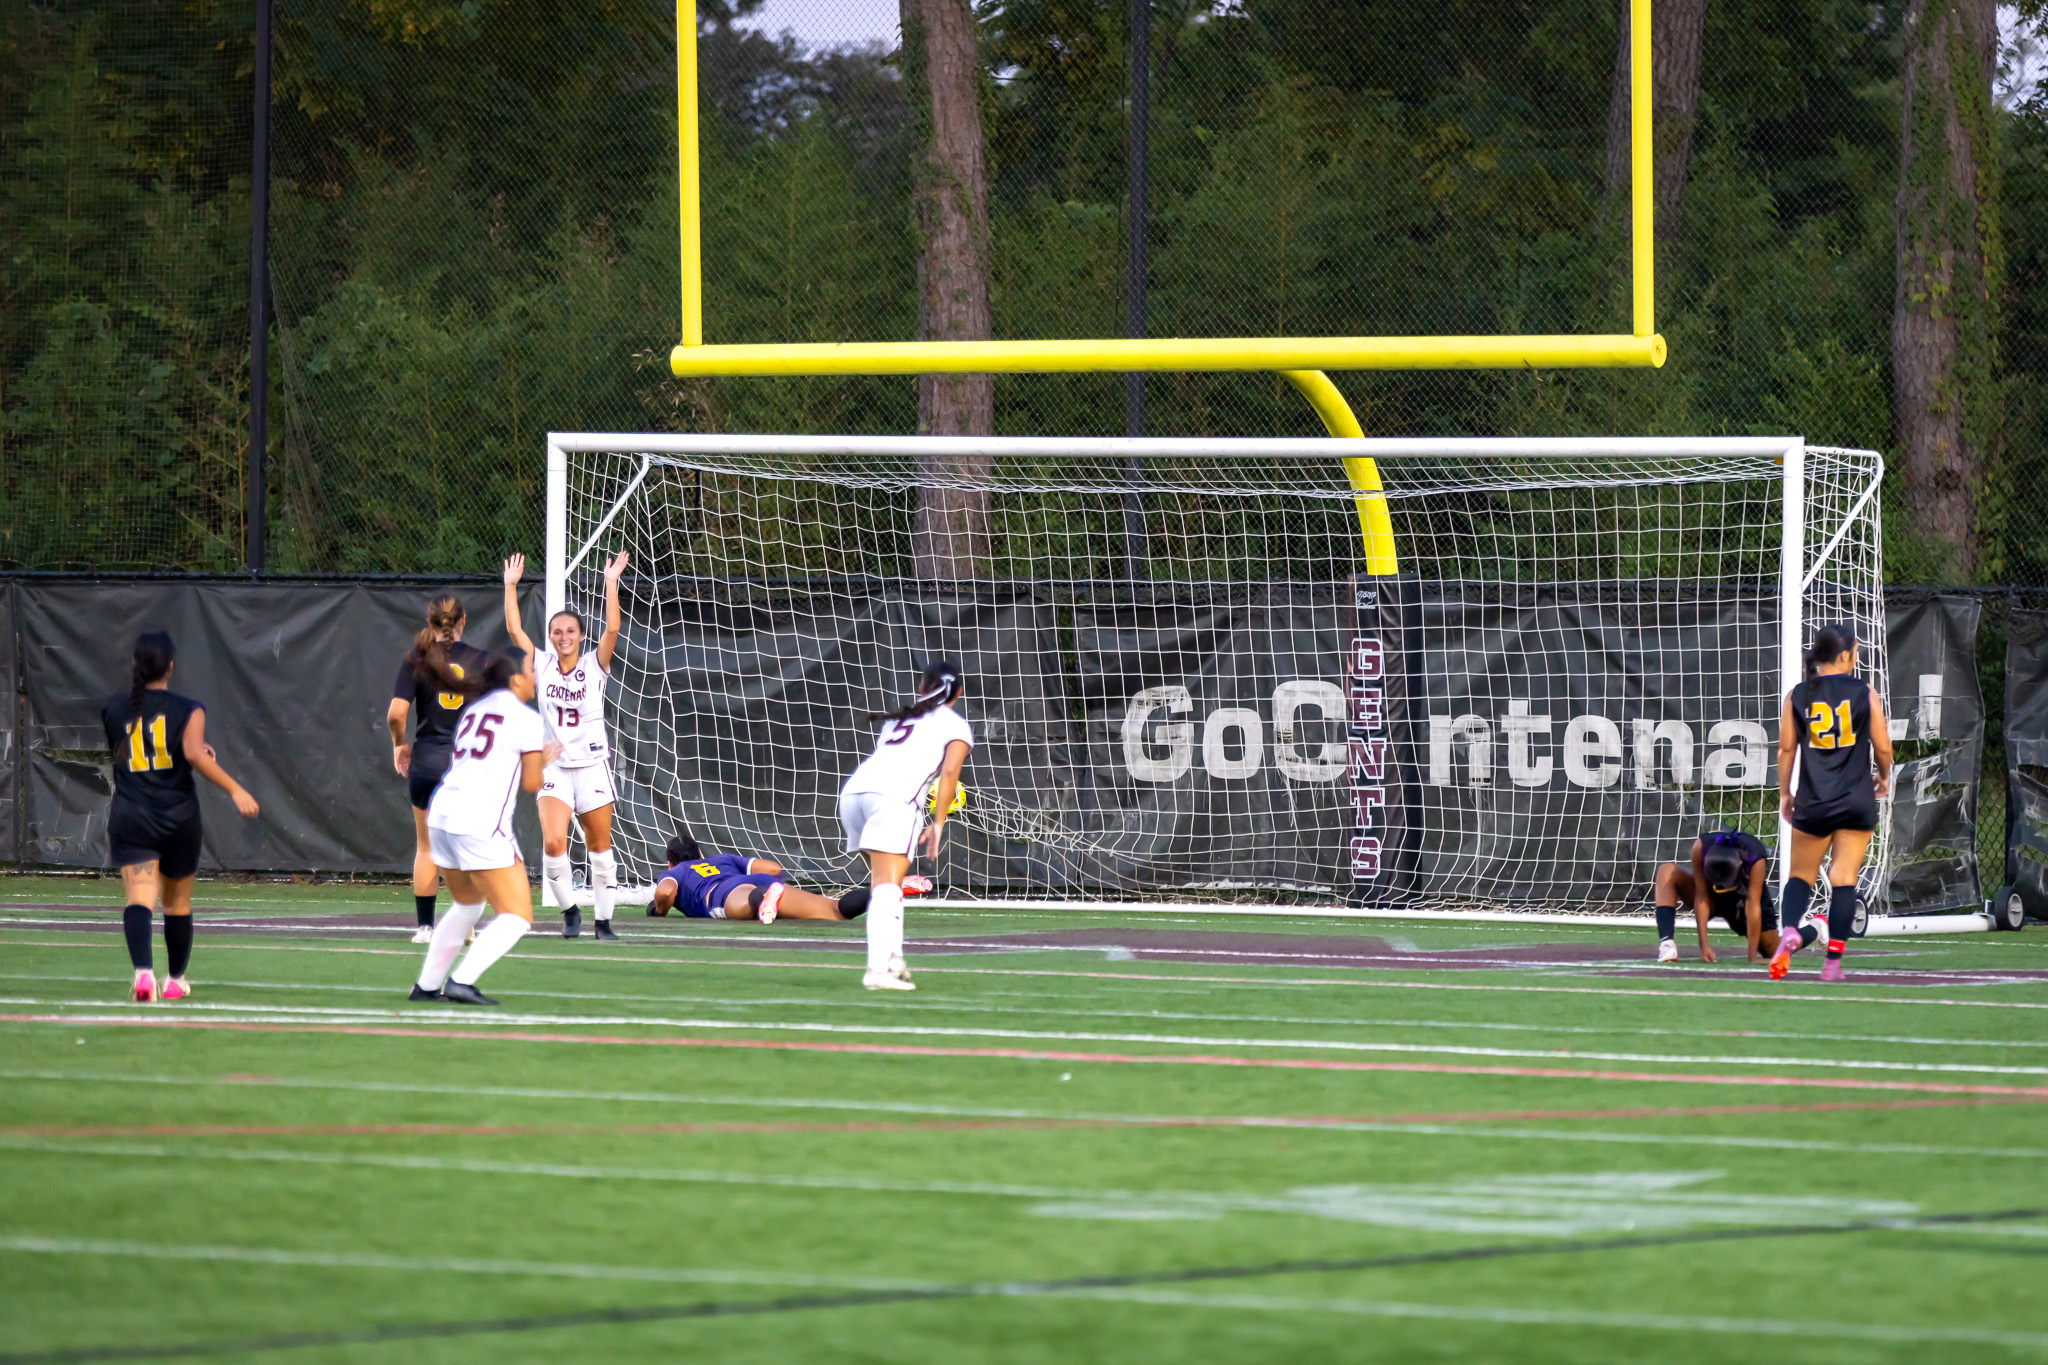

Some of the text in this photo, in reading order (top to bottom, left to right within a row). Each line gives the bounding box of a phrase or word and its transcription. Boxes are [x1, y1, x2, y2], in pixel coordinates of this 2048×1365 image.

[454, 713, 505, 760] 25
[556, 706, 580, 727] 13
[885, 720, 915, 745] 5
[1806, 700, 1856, 749] 21
[126, 715, 173, 773] 11
[1347, 637, 1387, 879] GENTS
